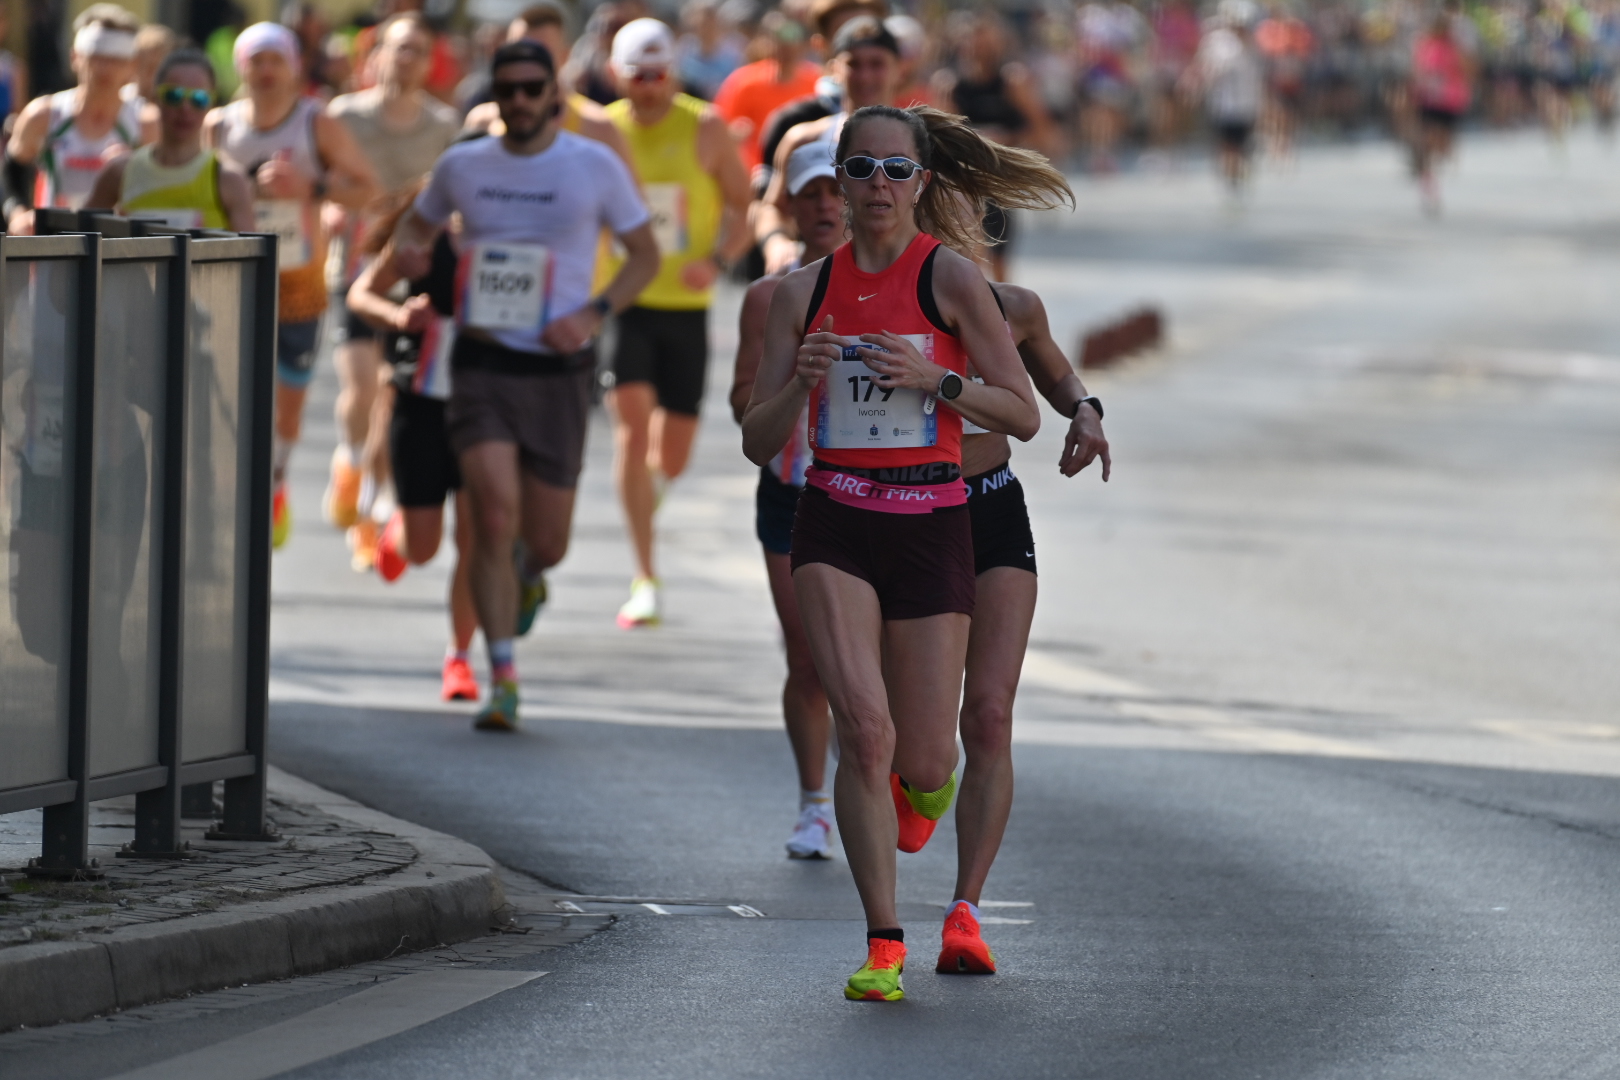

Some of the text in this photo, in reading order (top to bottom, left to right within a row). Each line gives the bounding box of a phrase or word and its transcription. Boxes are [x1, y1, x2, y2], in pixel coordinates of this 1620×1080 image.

[480, 271, 534, 296] 1509
[848, 375, 896, 402] 179
[858, 408, 886, 416] Iwona
